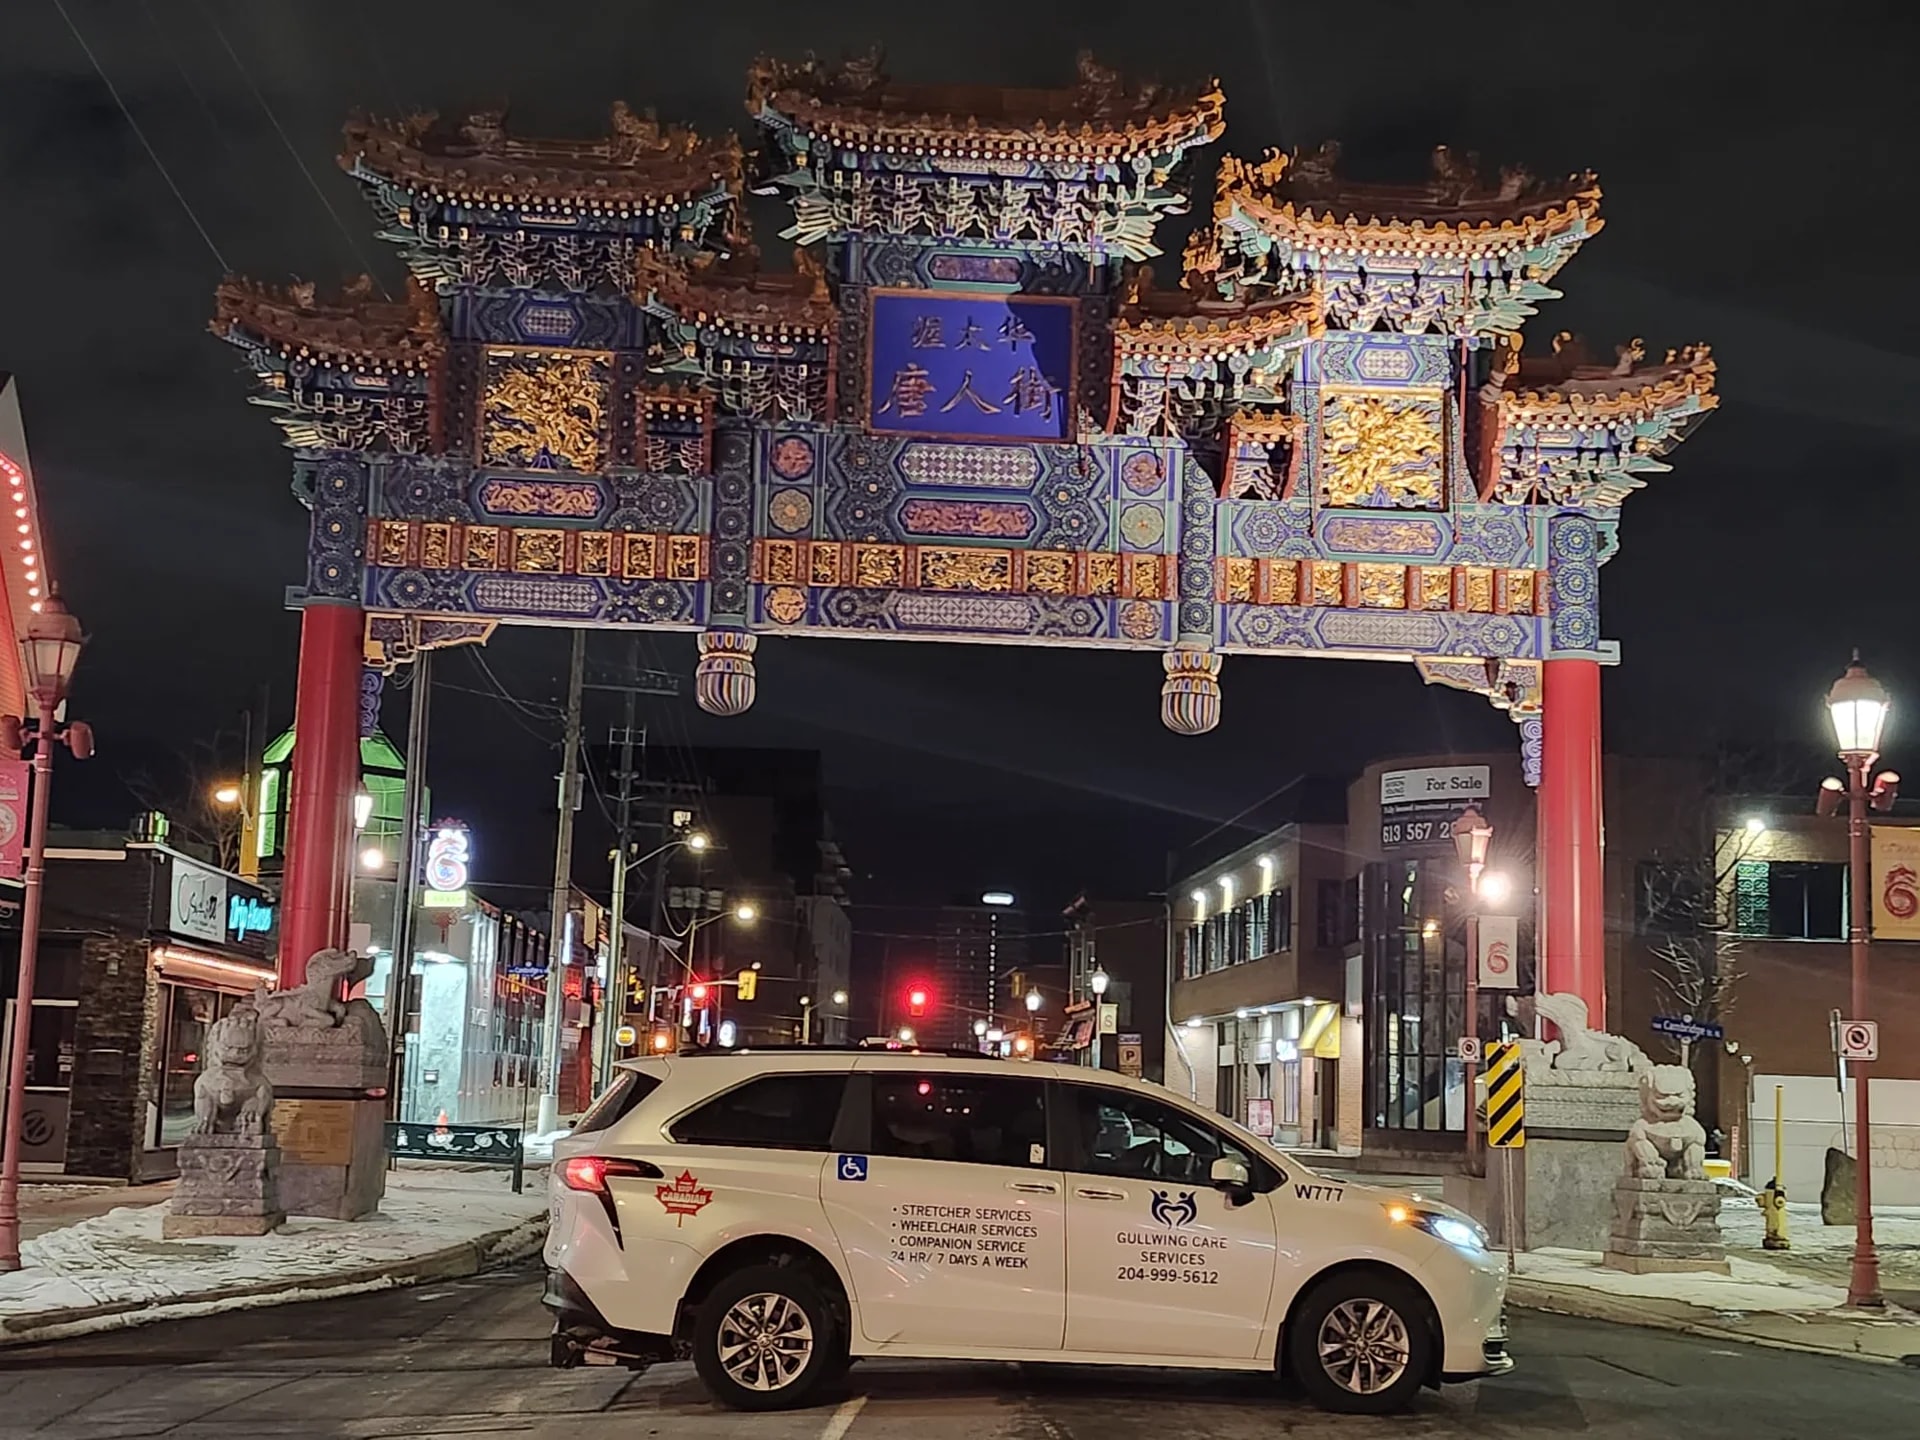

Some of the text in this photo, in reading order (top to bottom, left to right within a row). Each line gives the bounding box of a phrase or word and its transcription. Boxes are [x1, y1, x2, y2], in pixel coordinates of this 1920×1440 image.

[878, 362, 1062, 423] 唐人街
[1425, 776, 1482, 791] For Sale
[1382, 824, 1401, 843] 613
[1406, 822, 1432, 841] 567
[661, 1191, 706, 1205] CANADIAN
[1294, 1184, 1344, 1202] W777
[901, 1204, 1032, 1222] STRETCHER SERVICES
[900, 1219, 1038, 1238] WHEELCHAIR SERVICES
[899, 1235, 1026, 1253] COMPANION SERVICE
[1116, 1231, 1228, 1249] GULLWING CARE
[937, 1253, 945, 1264] 7
[949, 1253, 978, 1266] DAYS
[982, 1256, 991, 1267] A
[995, 1256, 1029, 1269] WEEK
[1140, 1250, 1206, 1266] SERVICES
[1117, 1266, 1219, 1285] 204-999-5612
